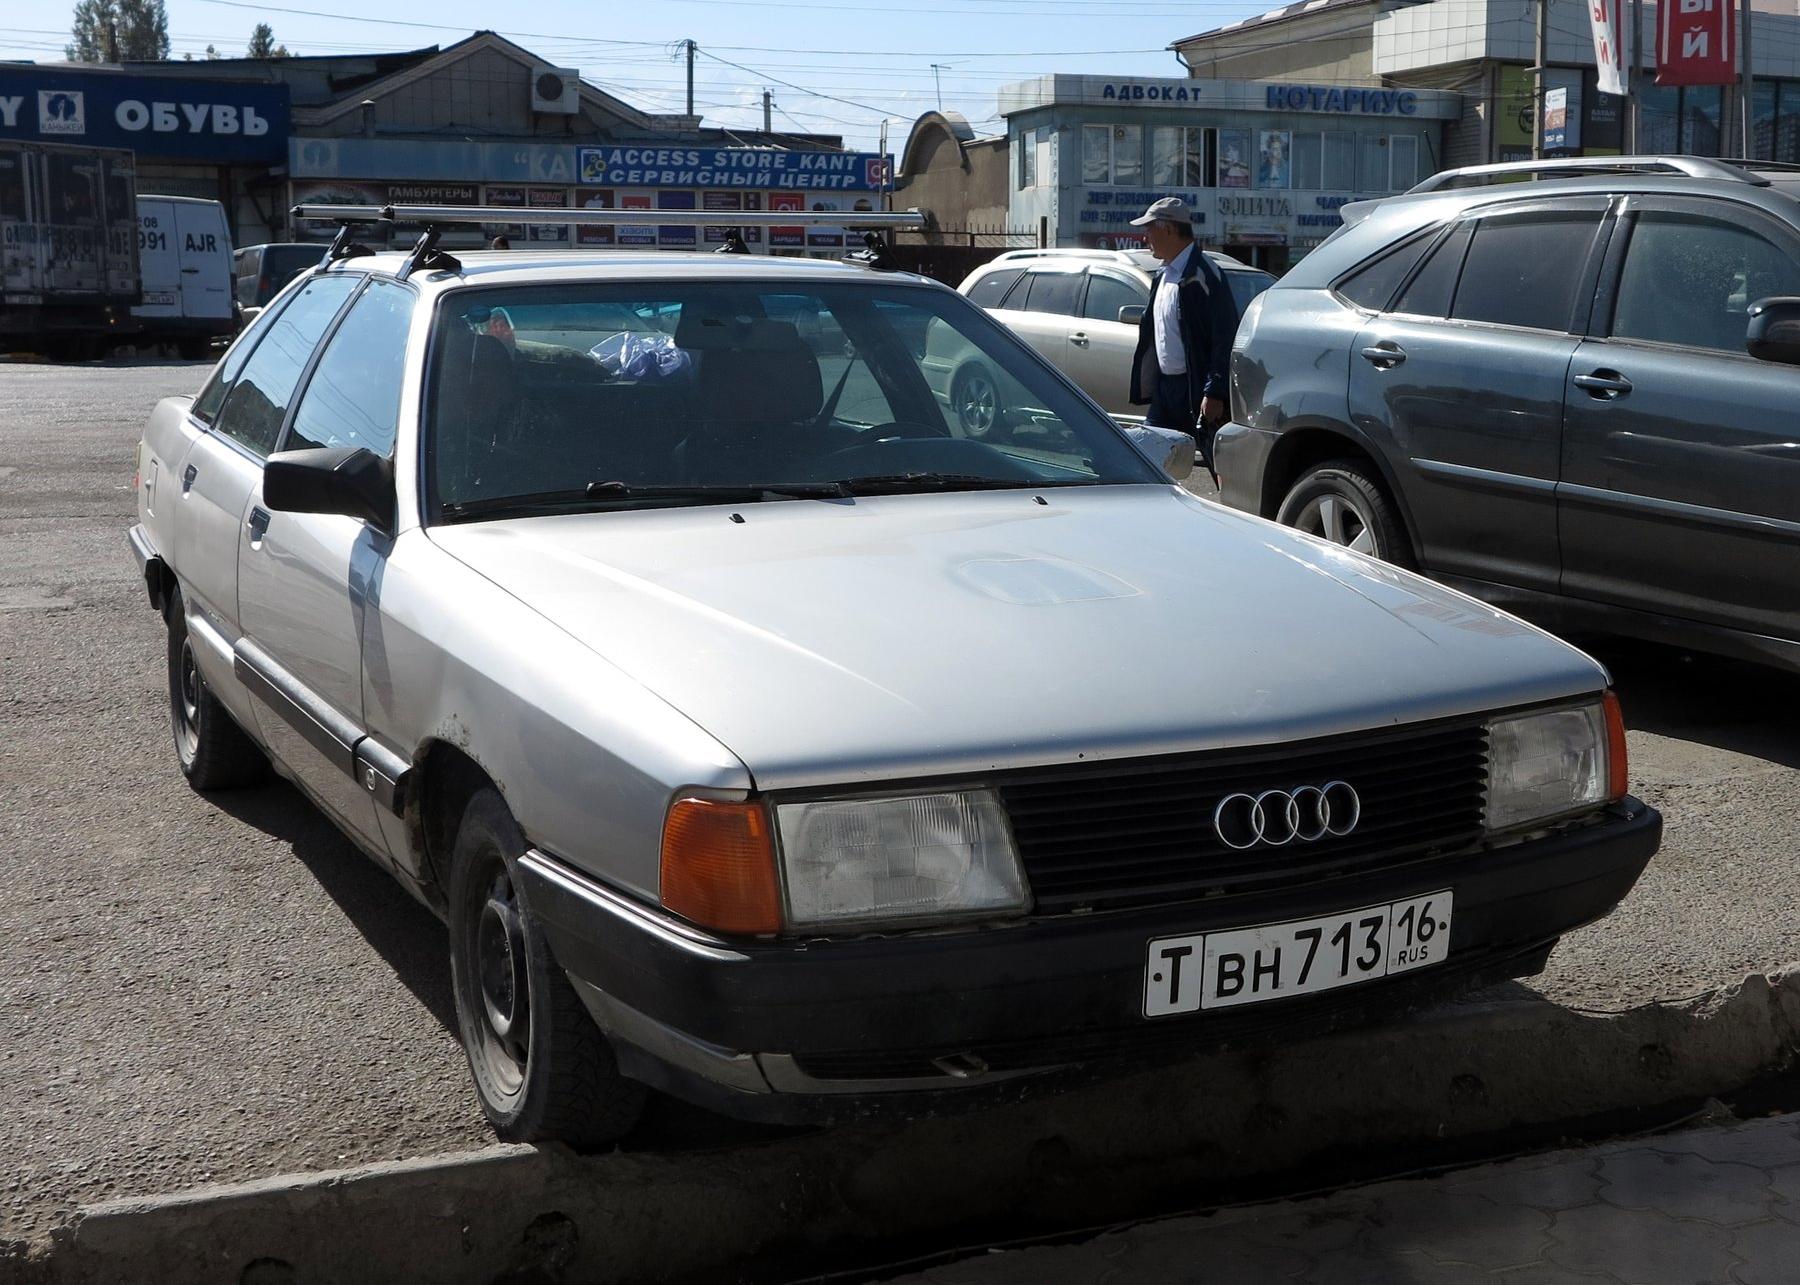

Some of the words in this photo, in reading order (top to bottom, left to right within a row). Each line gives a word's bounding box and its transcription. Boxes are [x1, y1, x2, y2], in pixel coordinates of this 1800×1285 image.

[1103, 84, 1201, 101] АДВОКАТ
[1266, 85, 1418, 114] НОТАРИУС
[115, 99, 269, 136] ОБУВЬ
[609, 167, 771, 186] СЕРВИСНЫЙ
[779, 174, 857, 188] ЦЕНТР
[388, 185, 473, 199] ГАМБУРГЕРЫ
[1218, 196, 1293, 217] ЭЛИТА
[185, 233, 217, 253] AJR
[1397, 901, 1436, 947] 16
[1397, 945, 1429, 967] RUS
